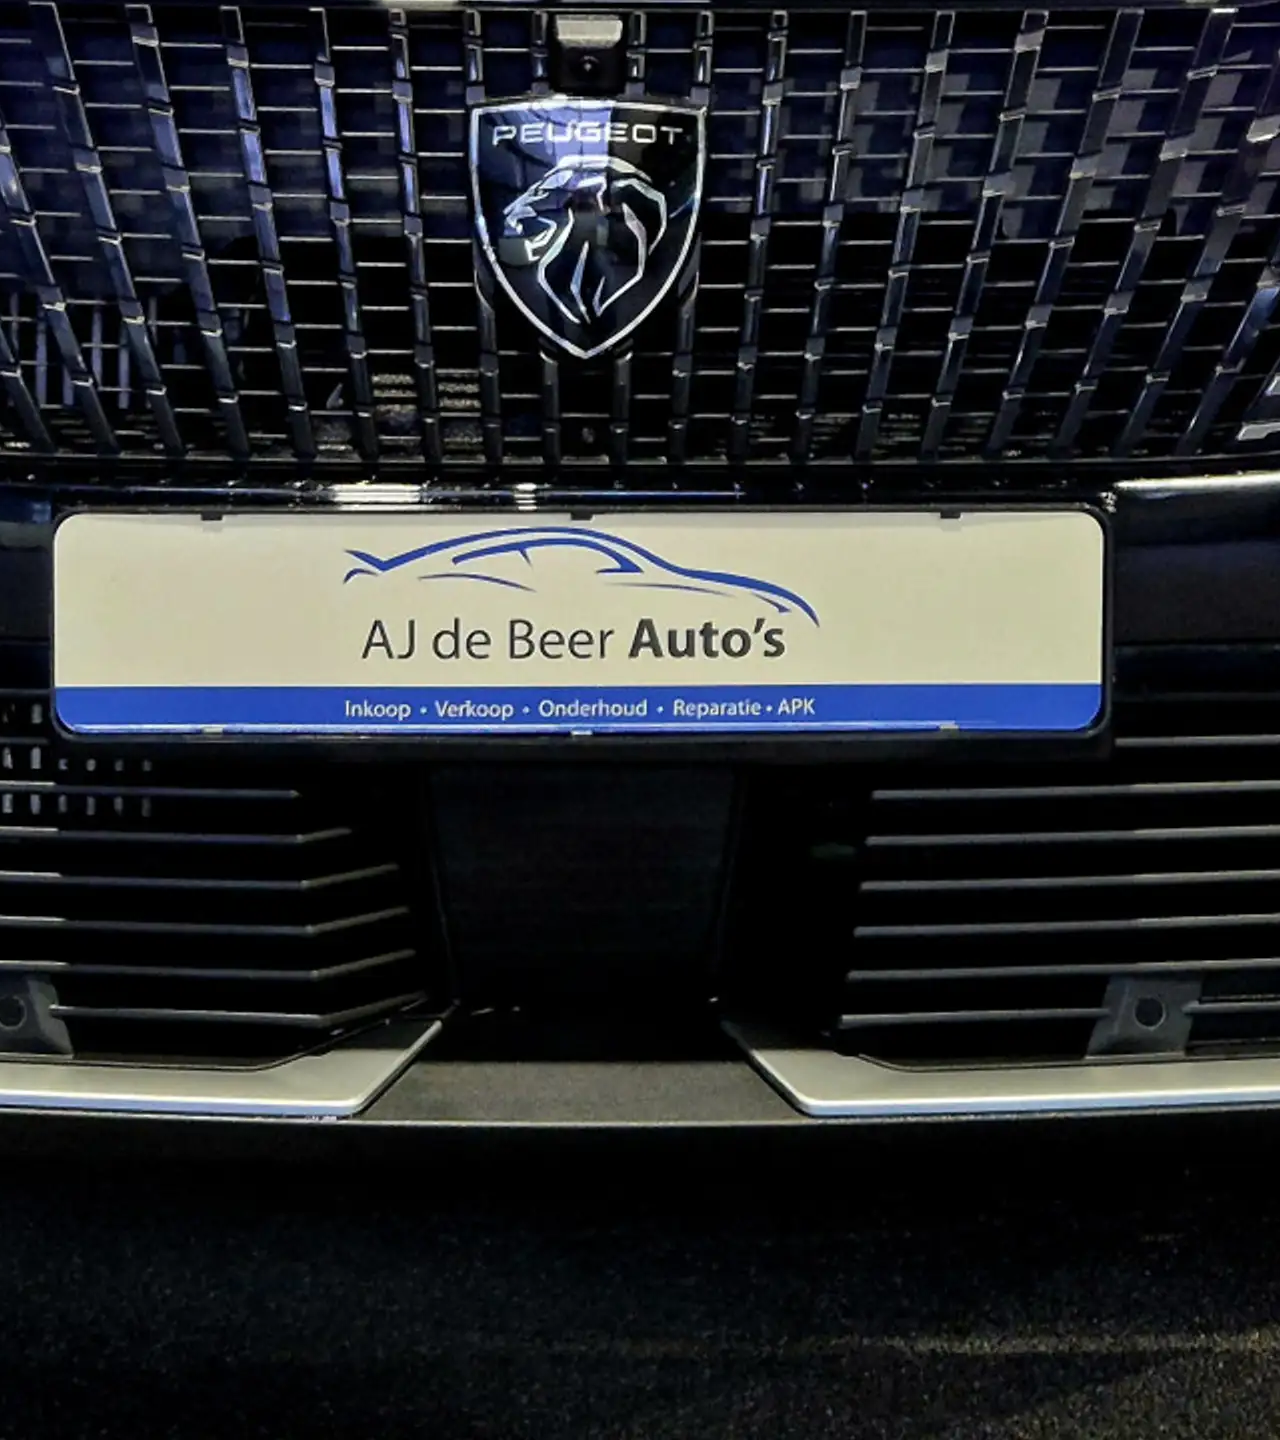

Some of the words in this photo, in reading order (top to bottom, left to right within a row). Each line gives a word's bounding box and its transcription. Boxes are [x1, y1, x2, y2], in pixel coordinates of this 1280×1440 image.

[491, 122, 684, 147] PEUGEOT
[361, 618, 416, 660] AJ
[432, 617, 492, 660] de
[508, 618, 615, 660] Beer
[628, 617, 786, 659] Auto's
[344, 699, 412, 721] Inkoop
[435, 699, 514, 721] Verkoop
[538, 698, 648, 718] Onderhoud
[673, 698, 762, 719] Reparatie
[777, 697, 816, 716] APK
